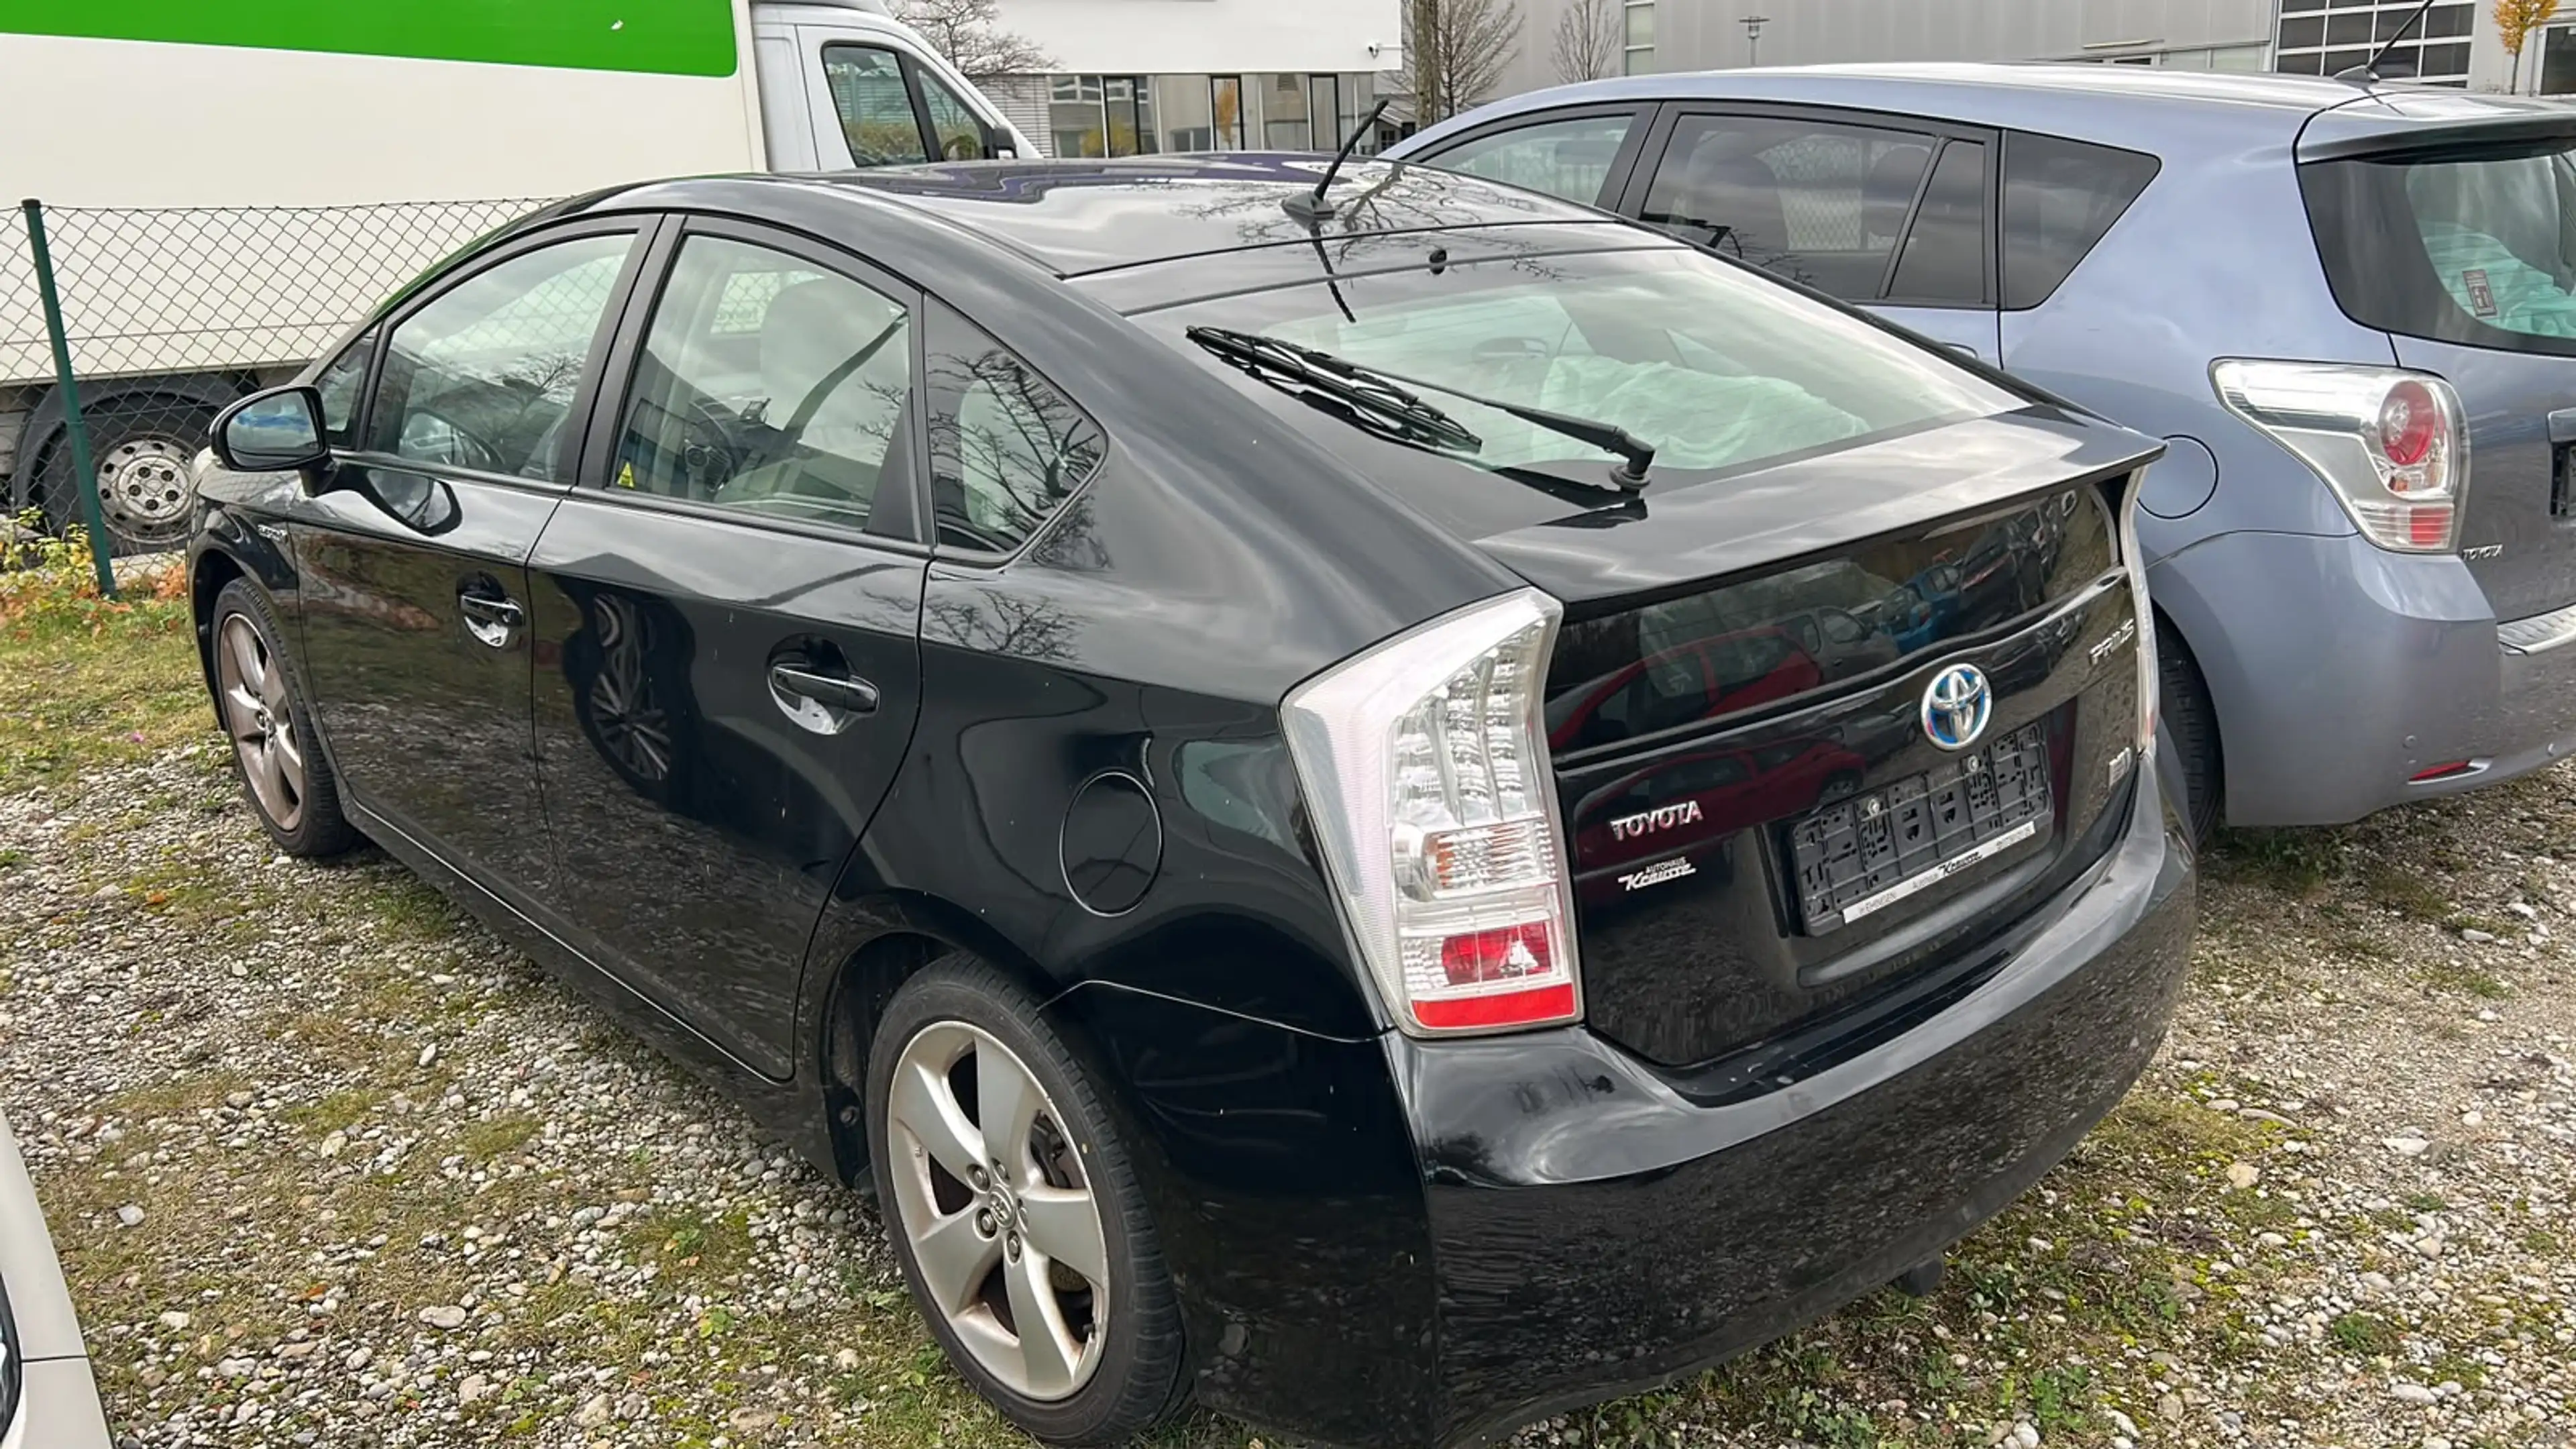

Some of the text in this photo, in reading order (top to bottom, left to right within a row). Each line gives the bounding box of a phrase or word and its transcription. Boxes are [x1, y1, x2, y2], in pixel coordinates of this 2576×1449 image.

[2463, 544, 2503, 561] TOYOTA
[2089, 618, 2134, 665] PRIUS
[1609, 800, 1703, 841] TOYOTA
